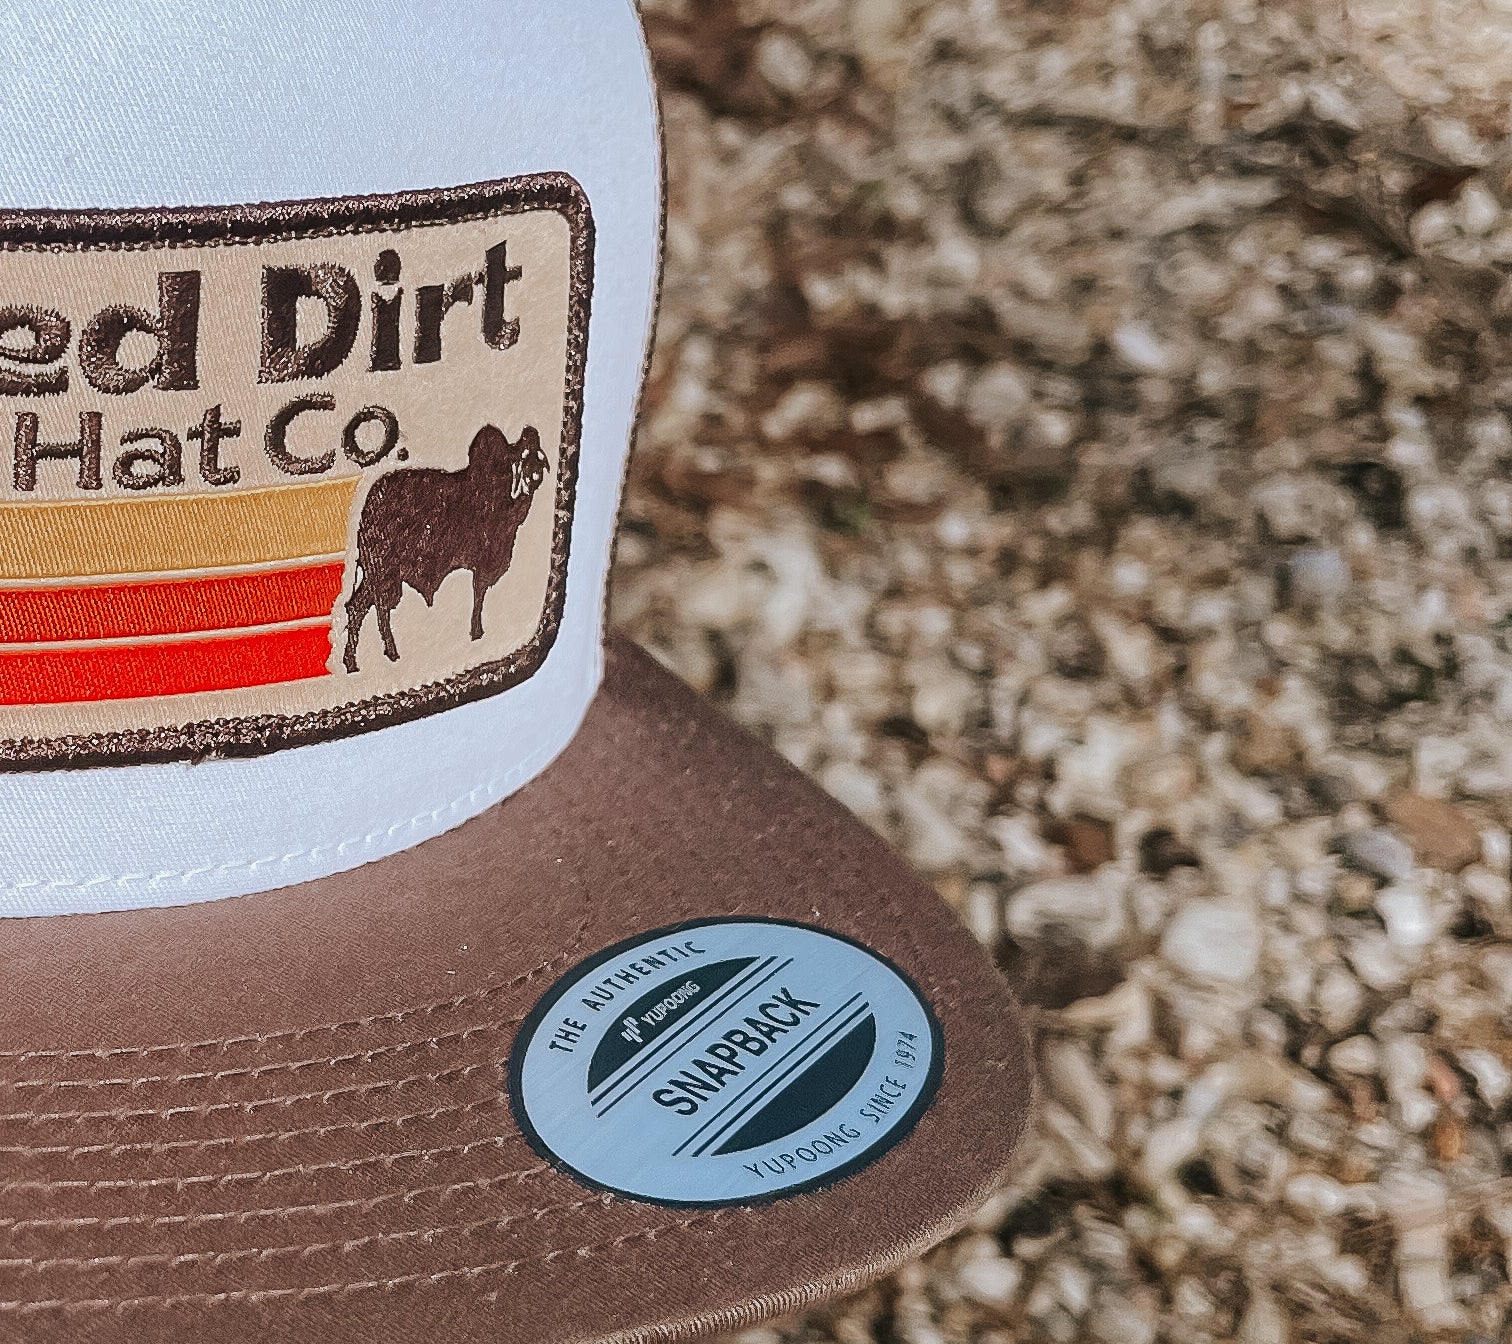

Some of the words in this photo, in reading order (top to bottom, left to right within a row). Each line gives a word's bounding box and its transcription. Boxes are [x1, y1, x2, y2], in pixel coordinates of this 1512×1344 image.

[256, 239, 524, 385] Dirt
[13, 402, 242, 493] Hat
[263, 392, 410, 477] Co.
[549, 1017, 587, 1053] THE
[581, 940, 706, 1012] AUTHENTIC
[640, 980, 701, 1027] YUPOONG
[651, 986, 821, 1116] SNAPBACK
[742, 1123, 861, 1179] YUPOONG
[859, 1075, 907, 1125] SINCE
